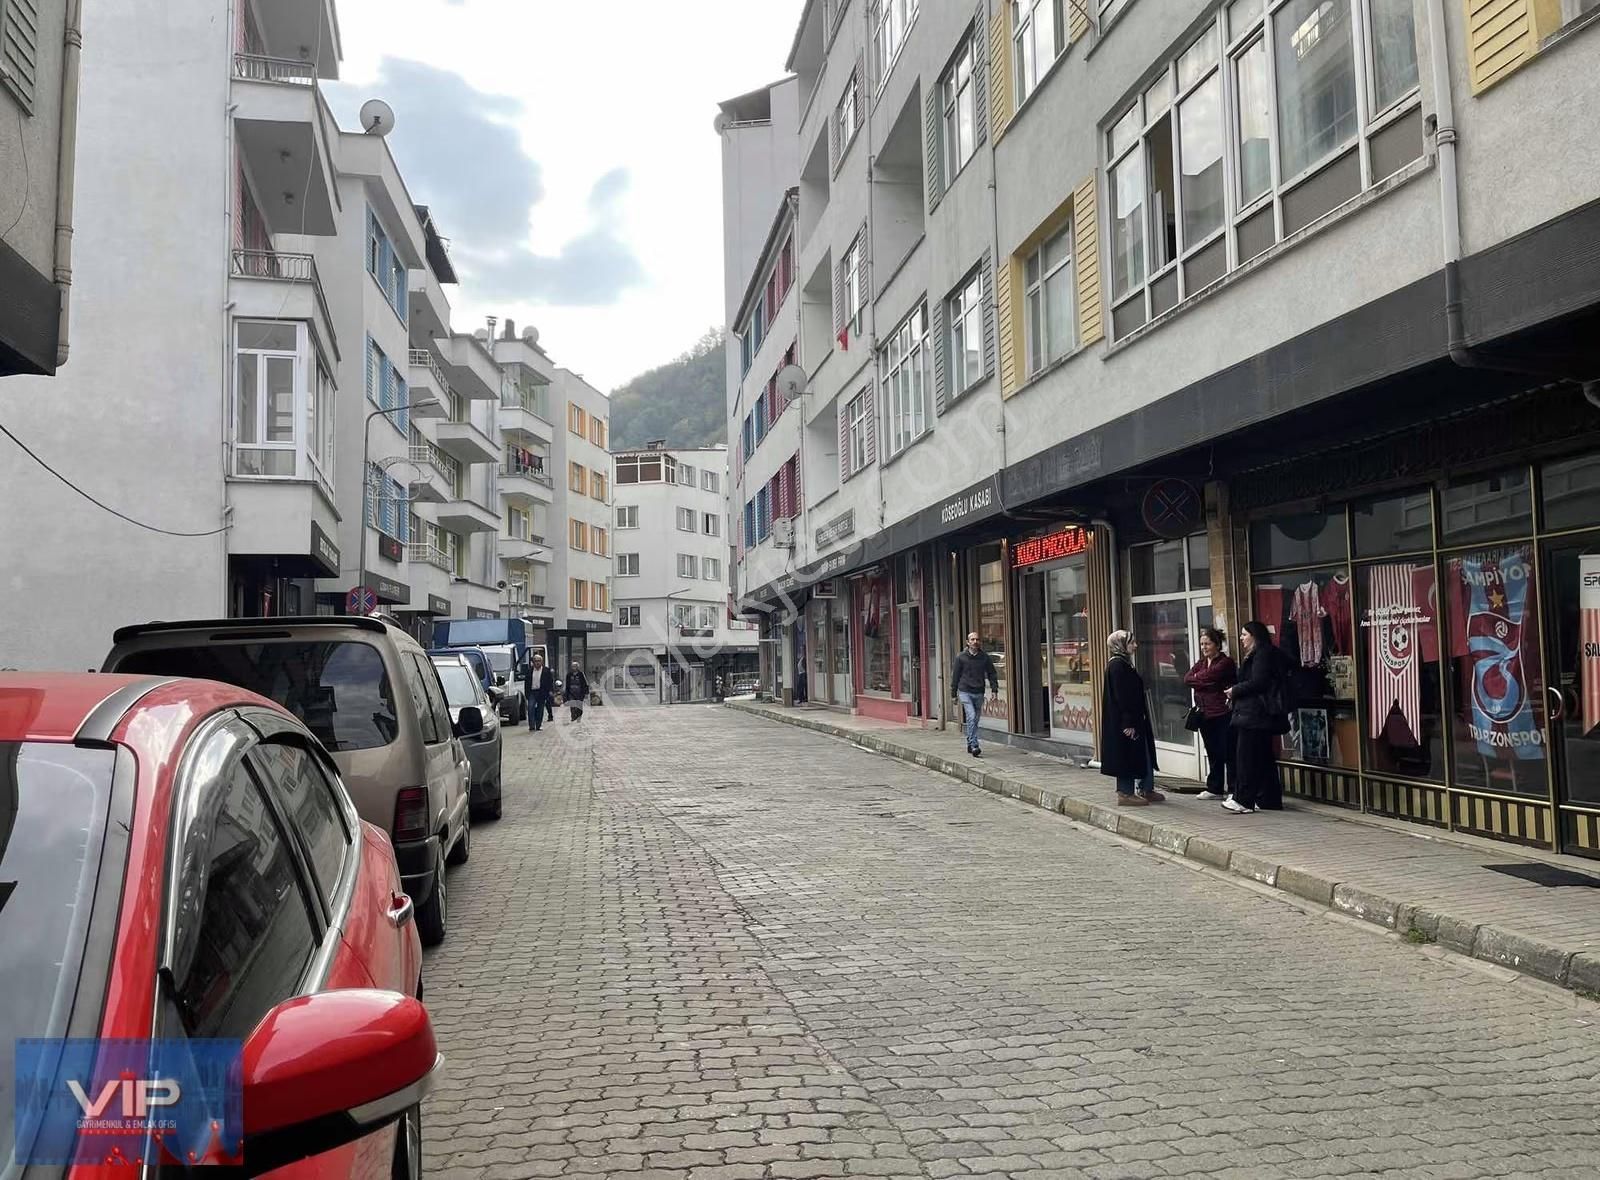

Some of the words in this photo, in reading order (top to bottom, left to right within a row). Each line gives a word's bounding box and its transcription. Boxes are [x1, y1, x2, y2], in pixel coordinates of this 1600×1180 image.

[941, 497, 968, 525] KÖSEOĞLU
[969, 487, 992, 512] KASABI
[1017, 539, 1041, 565] KUZU
[1583, 576, 1600, 587] SP
